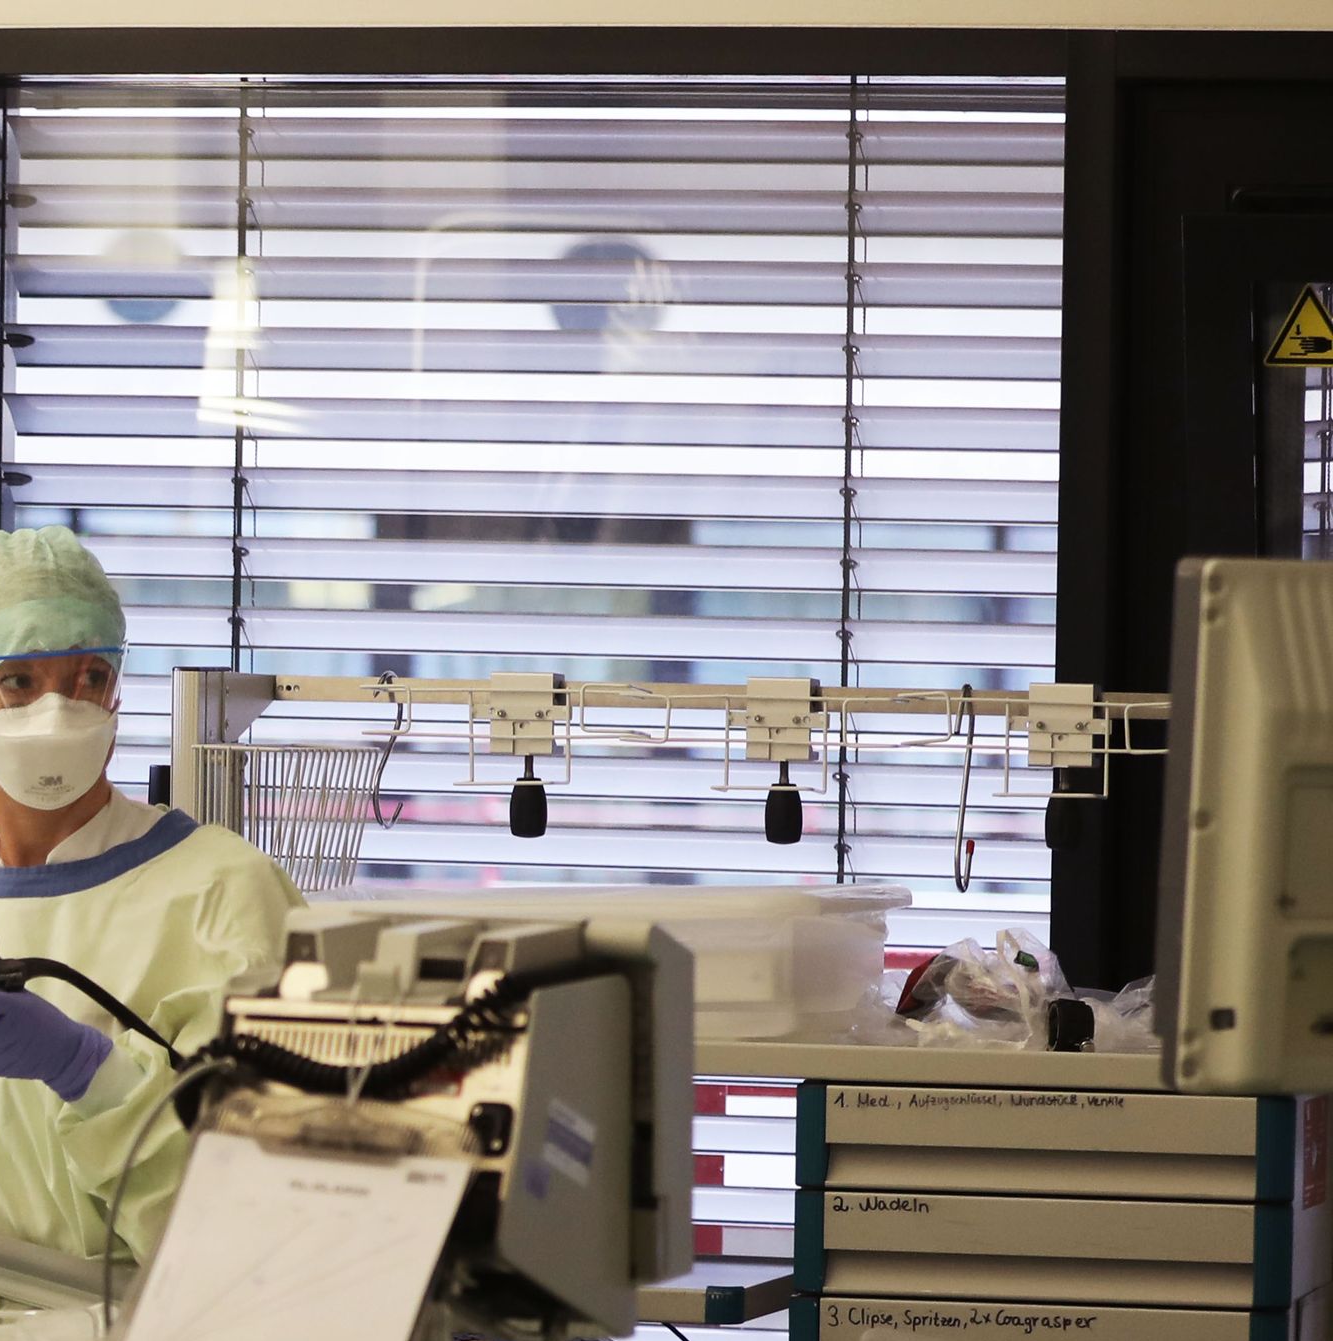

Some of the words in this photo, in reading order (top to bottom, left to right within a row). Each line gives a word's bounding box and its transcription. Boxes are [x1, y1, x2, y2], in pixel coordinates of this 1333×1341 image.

[833, 1091, 849, 1108] 1.
[832, 1195, 854, 1213] 2.
[858, 1195, 930, 1214] Nadeln
[827, 1304, 844, 1328] 3.
[848, 1307, 898, 1330] Clipse,
[903, 1308, 968, 1332] Spritzen,
[995, 1309, 1098, 1334] Coagrasper
